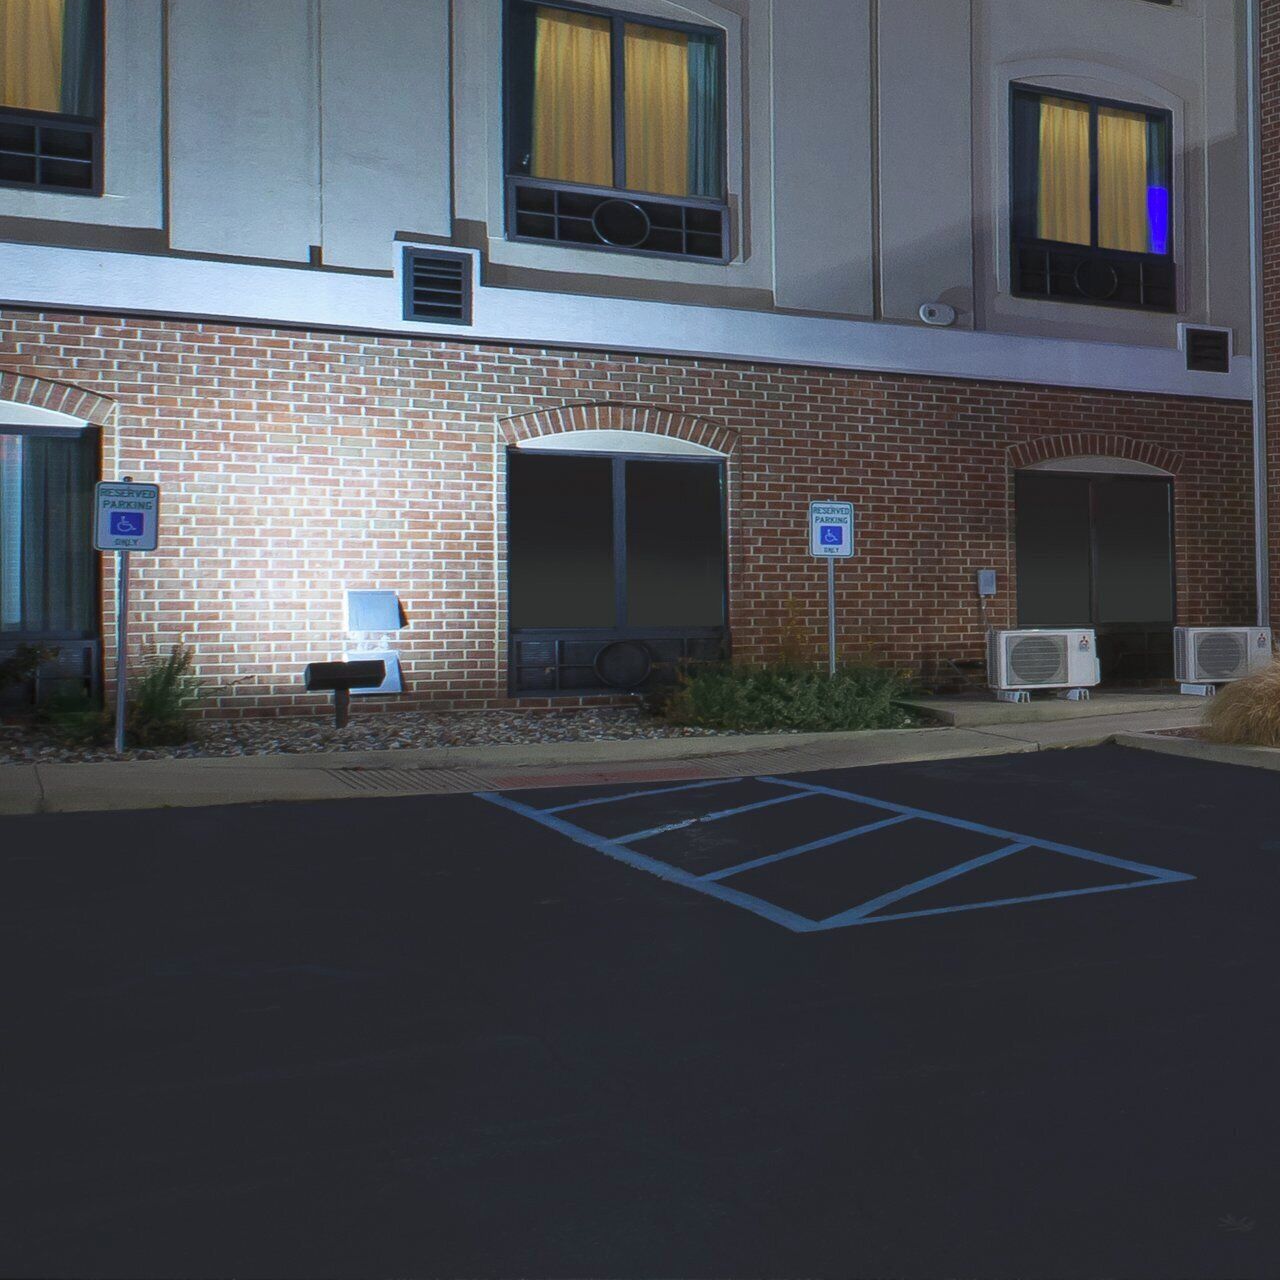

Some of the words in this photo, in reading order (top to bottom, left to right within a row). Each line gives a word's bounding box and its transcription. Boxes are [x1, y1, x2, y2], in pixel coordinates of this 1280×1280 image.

[100, 488, 156, 499] RESERVED
[103, 500, 152, 510] PARKING
[813, 506, 850, 515] RESERVED
[815, 516, 848, 524] PARKING
